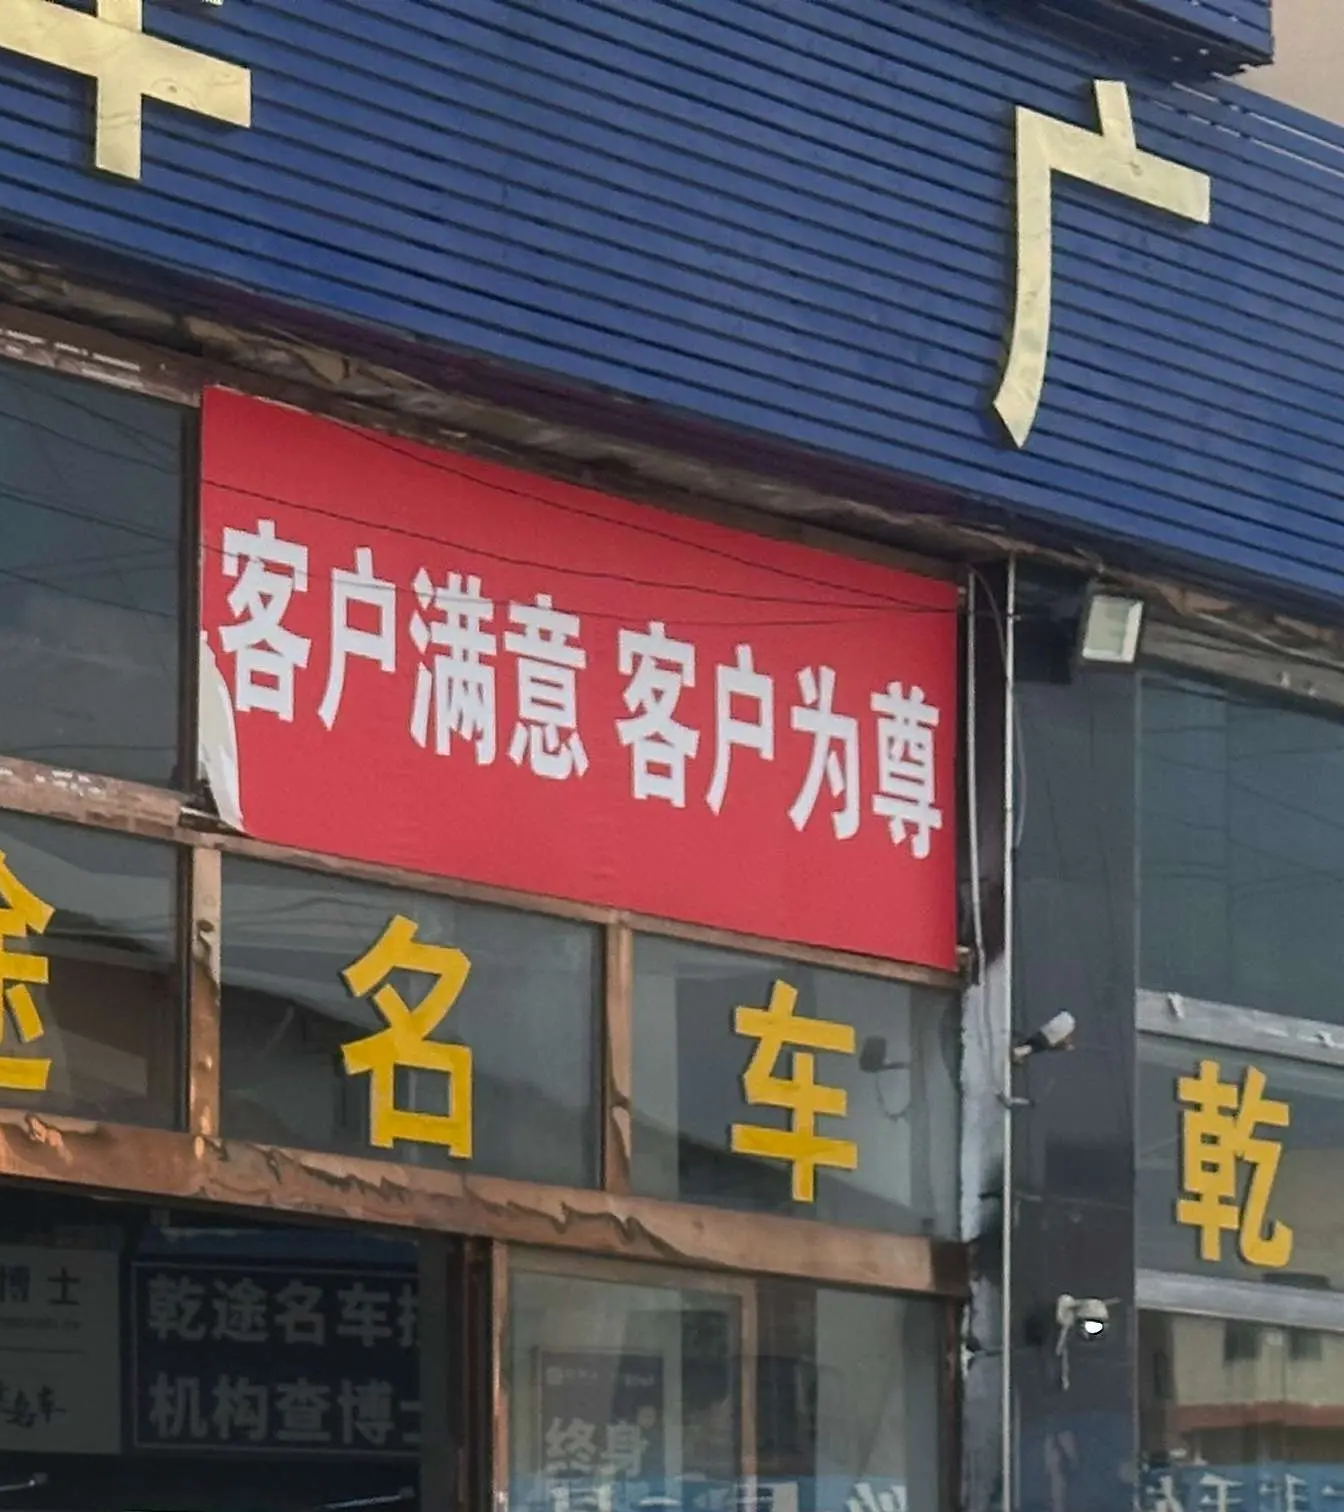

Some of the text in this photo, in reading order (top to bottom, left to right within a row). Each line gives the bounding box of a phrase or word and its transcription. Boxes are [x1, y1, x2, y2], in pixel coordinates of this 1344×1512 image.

[219, 518, 944, 860] 客户满意 客户为尊
[1176, 1059, 1293, 1267] 乾
